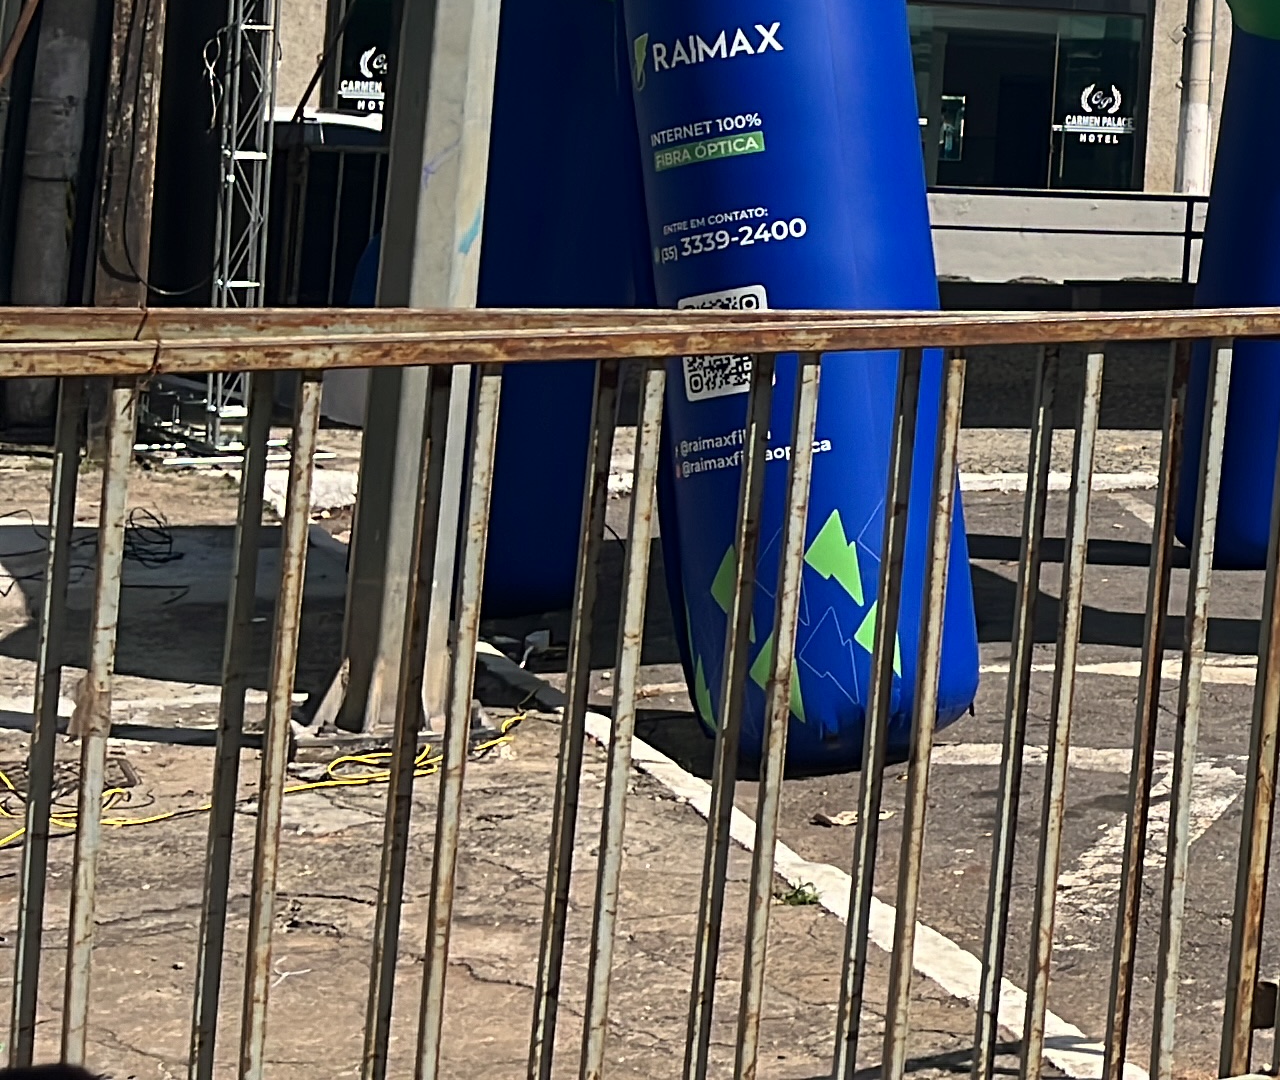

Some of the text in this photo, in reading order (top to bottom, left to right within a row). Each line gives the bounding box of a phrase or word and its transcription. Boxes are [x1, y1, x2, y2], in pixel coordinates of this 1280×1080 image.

[652, 21, 784, 72] RAIMAX
[341, 80, 383, 93] CARMEN
[650, 112, 762, 147] INTERNET 100%
[1065, 115, 1133, 127] CARMEN PALACE
[655, 136, 760, 169] FIBRA ÓPTICA
[1080, 133, 1118, 144] HOTEL
[663, 206, 769, 235] ENTRE EM CONTATO:
[680, 218, 808, 257] 3339-2400
